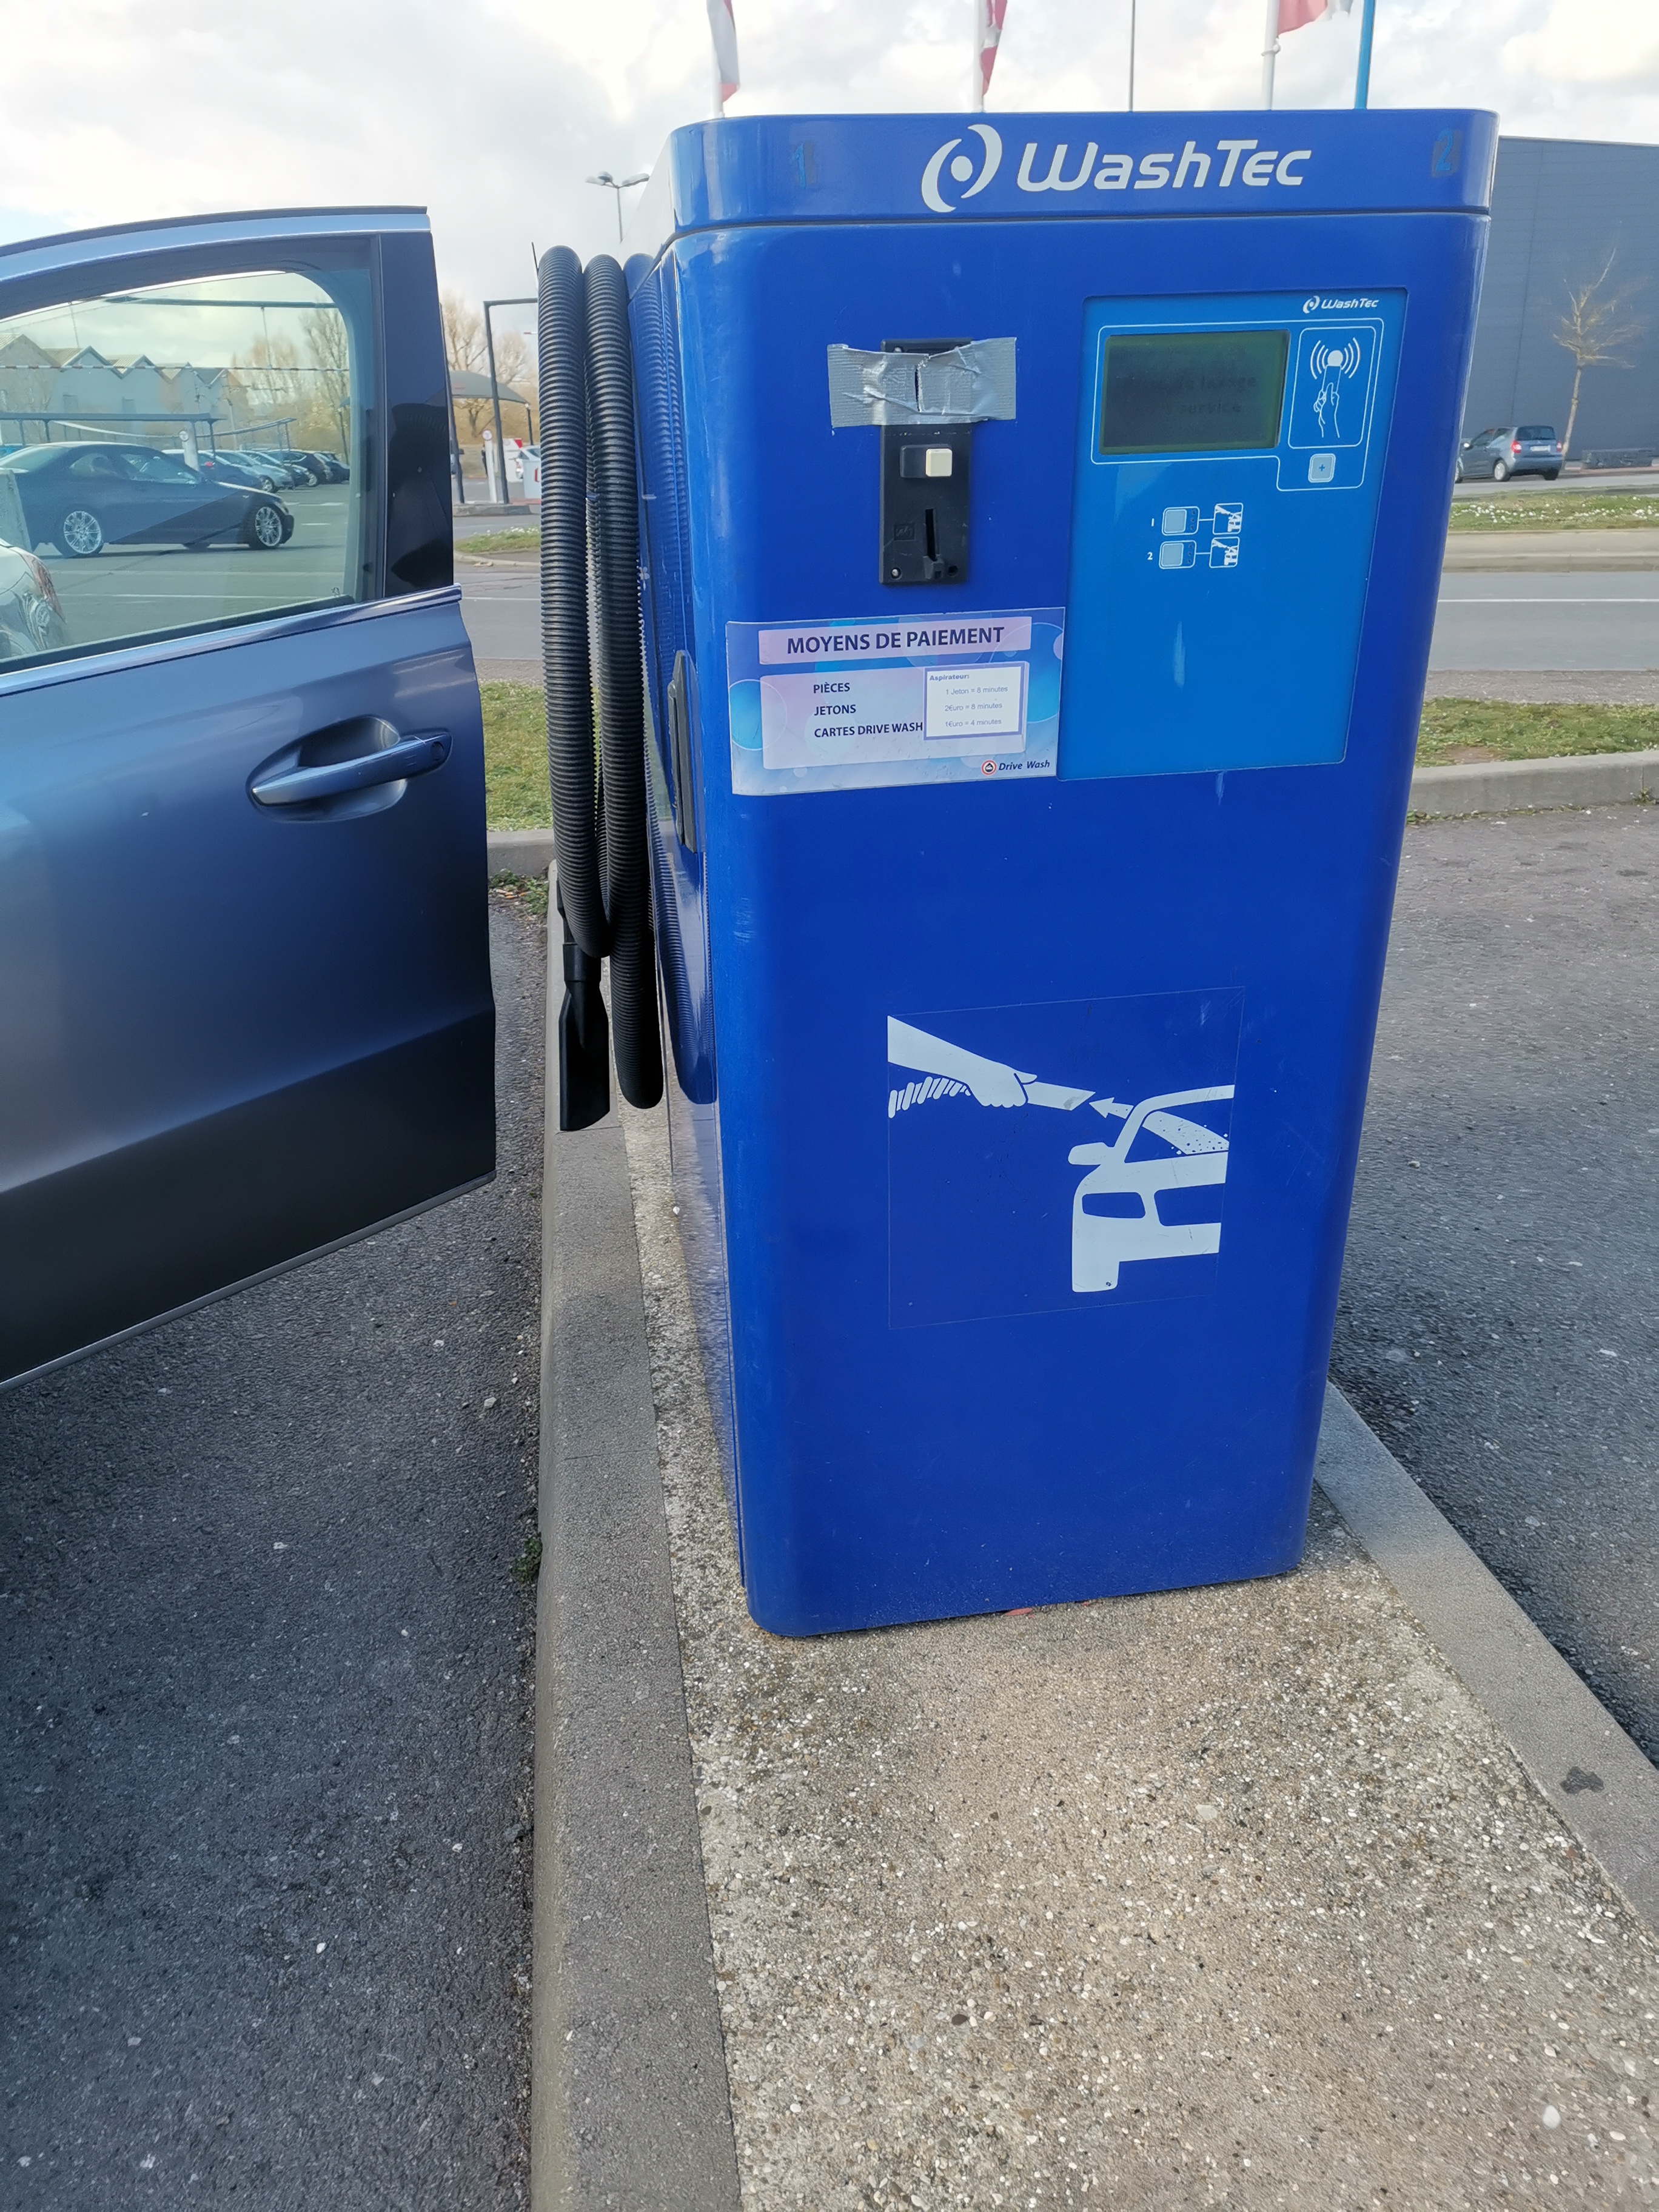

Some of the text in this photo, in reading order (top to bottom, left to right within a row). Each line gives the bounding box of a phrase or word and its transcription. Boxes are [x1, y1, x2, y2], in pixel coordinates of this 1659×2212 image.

[1017, 139, 1312, 192] WashTec
[1321, 298, 1379, 309] WashTec
[1147, 552, 1153, 560] 2
[787, 626, 1005, 654] MOYENS DE PAIEMENT
[813, 682, 850, 694] PIÈCES
[814, 704, 856, 716] JETONS
[814, 722, 923, 737] CARTES DRIVE WASH
[999, 760, 1050, 771] Drive Wash
